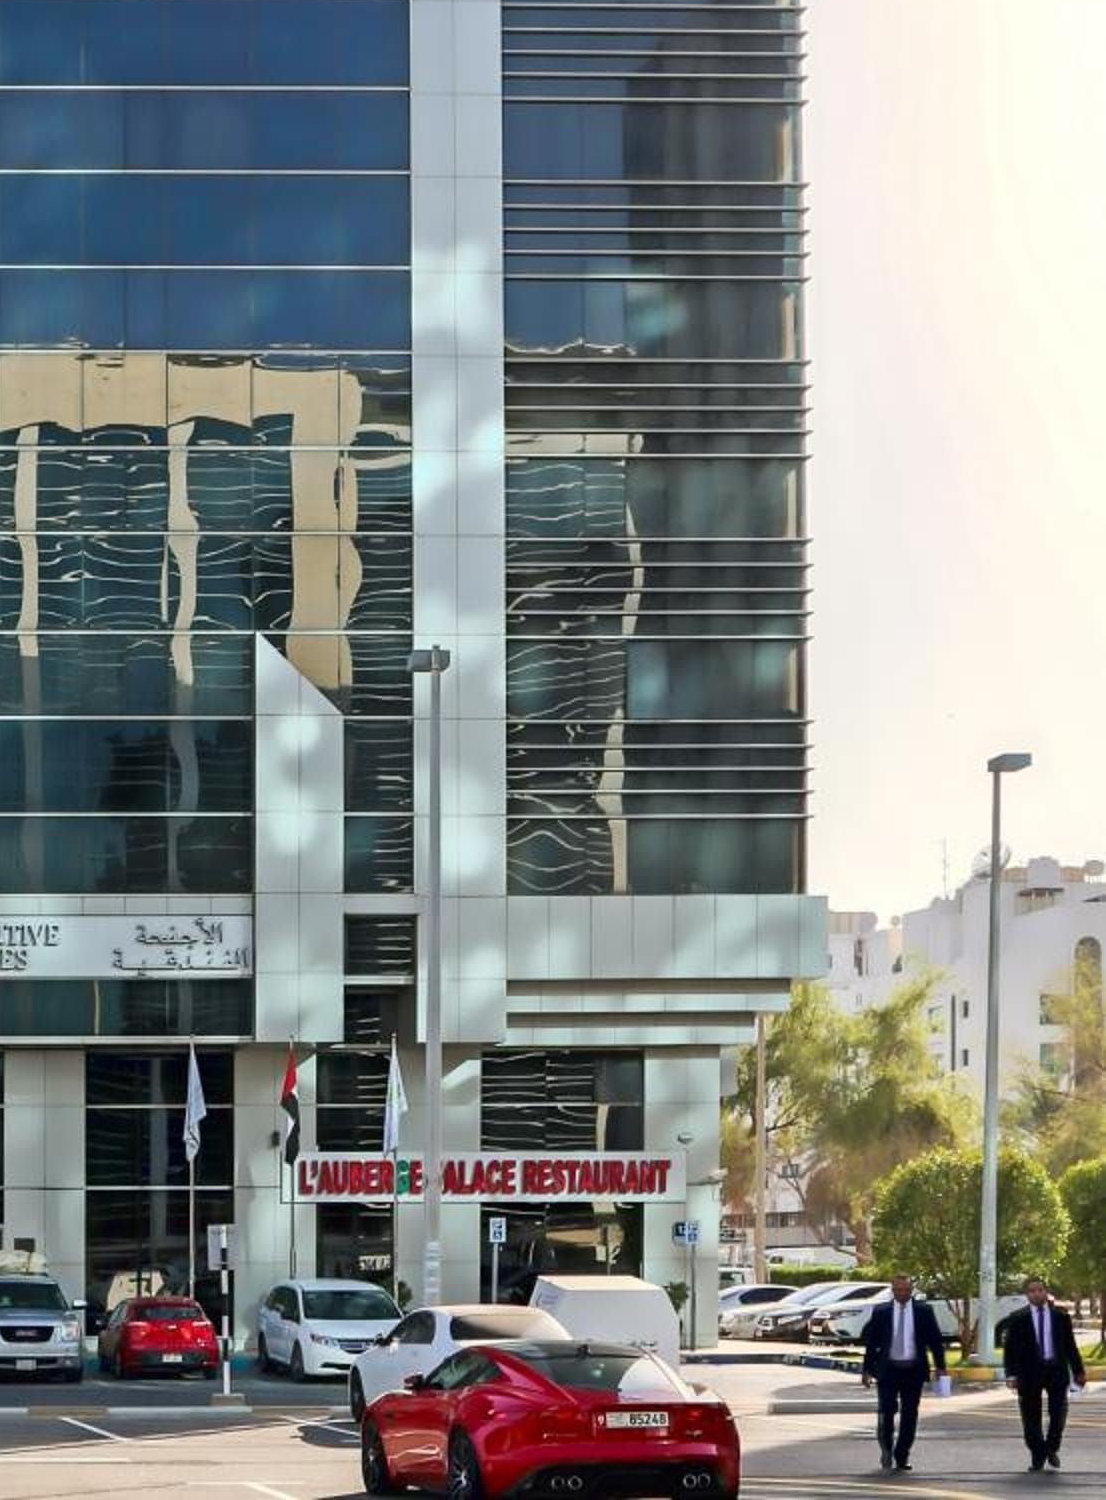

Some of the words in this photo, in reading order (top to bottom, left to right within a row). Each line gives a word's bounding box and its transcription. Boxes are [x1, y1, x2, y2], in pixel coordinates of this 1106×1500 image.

[134, 917, 224, 949] الأجنحة
[298, 1159, 424, 1196] L'AUBERGE
[439, 1159, 517, 1196] ALACE
[521, 1159, 672, 1196] RESTAURANT
